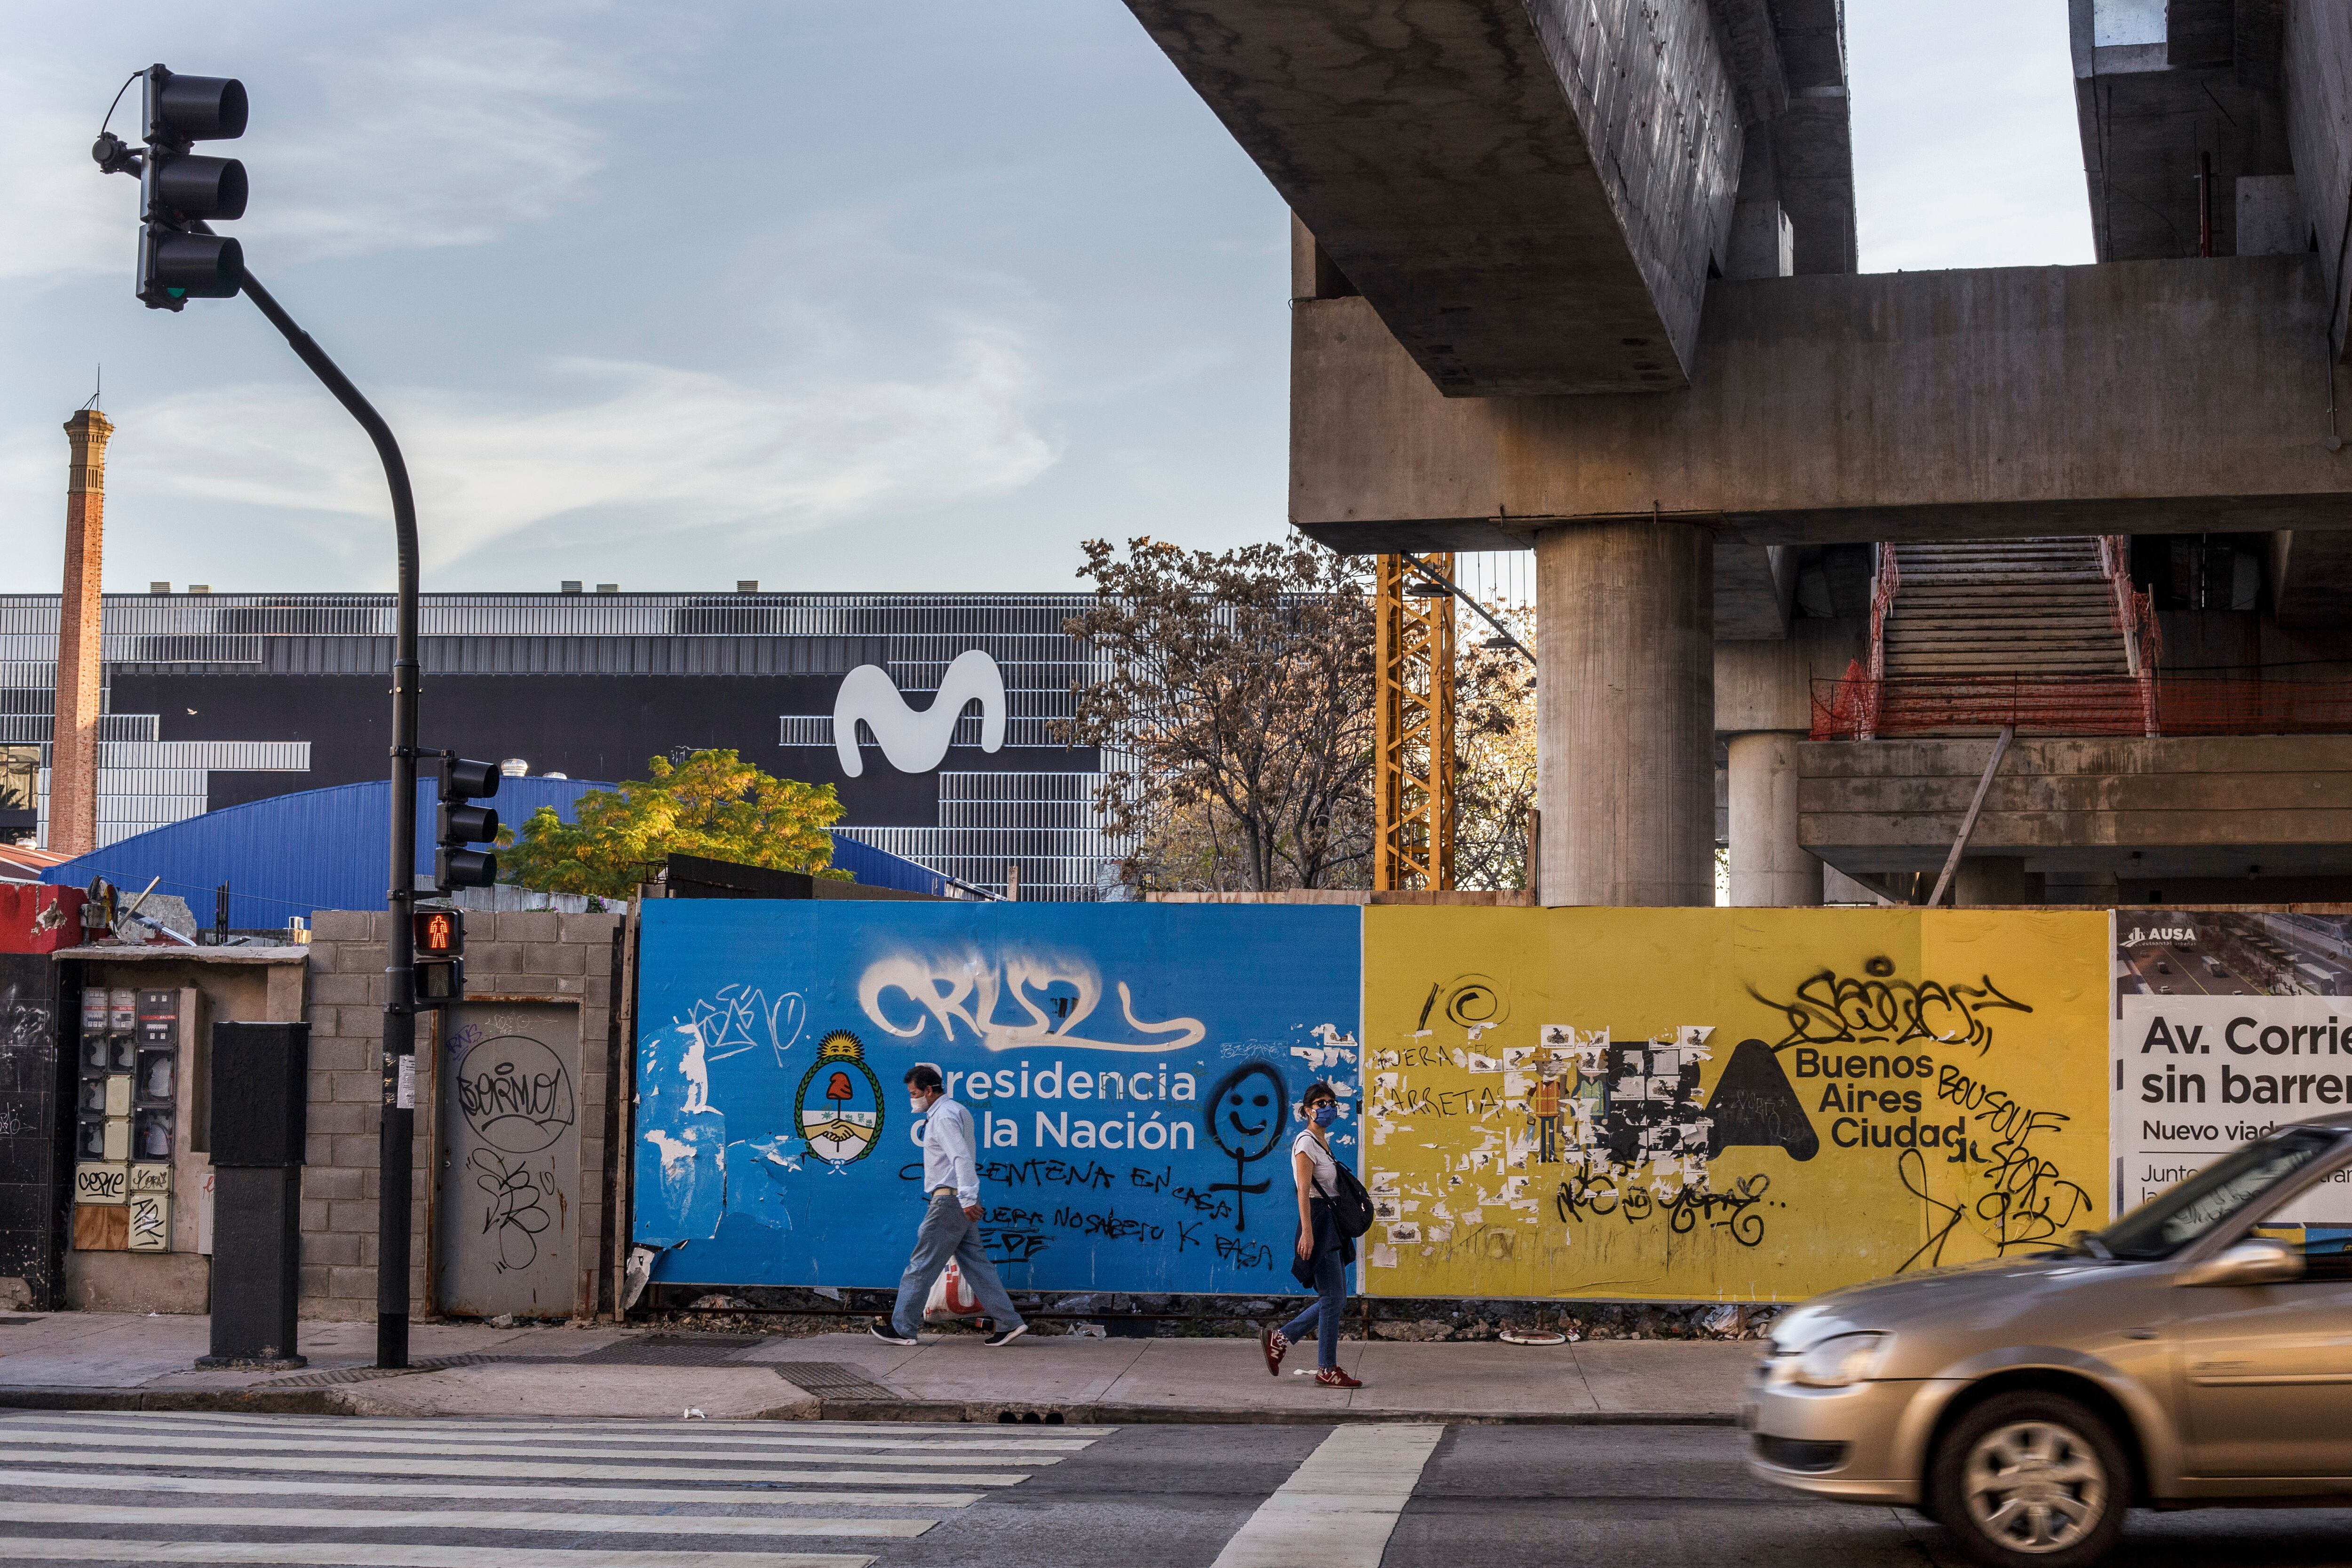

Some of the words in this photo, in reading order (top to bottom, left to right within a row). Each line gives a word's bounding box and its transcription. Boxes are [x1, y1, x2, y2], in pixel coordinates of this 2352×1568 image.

[2148, 928, 2196, 940] AUSA
[2141, 1016, 2209, 1054] Av.
[1796, 1048, 1934, 1078] Buenos
[1819, 1083, 1922, 1113] Aires
[2141, 1064, 2206, 1104] sin
[984, 1111, 1019, 1148] la
[1036, 1110, 1195, 1151] Nación
[1832, 1116, 1965, 1148] Ciudad
[2143, 1120, 2219, 1140] Nuevo
[1129, 1165, 1172, 1193] EN
[1172, 1187, 1232, 1219] CASA
[1054, 1206, 1084, 1229] NO
[1178, 1220, 1203, 1252] K
[1215, 1233, 1273, 1271] PASA
